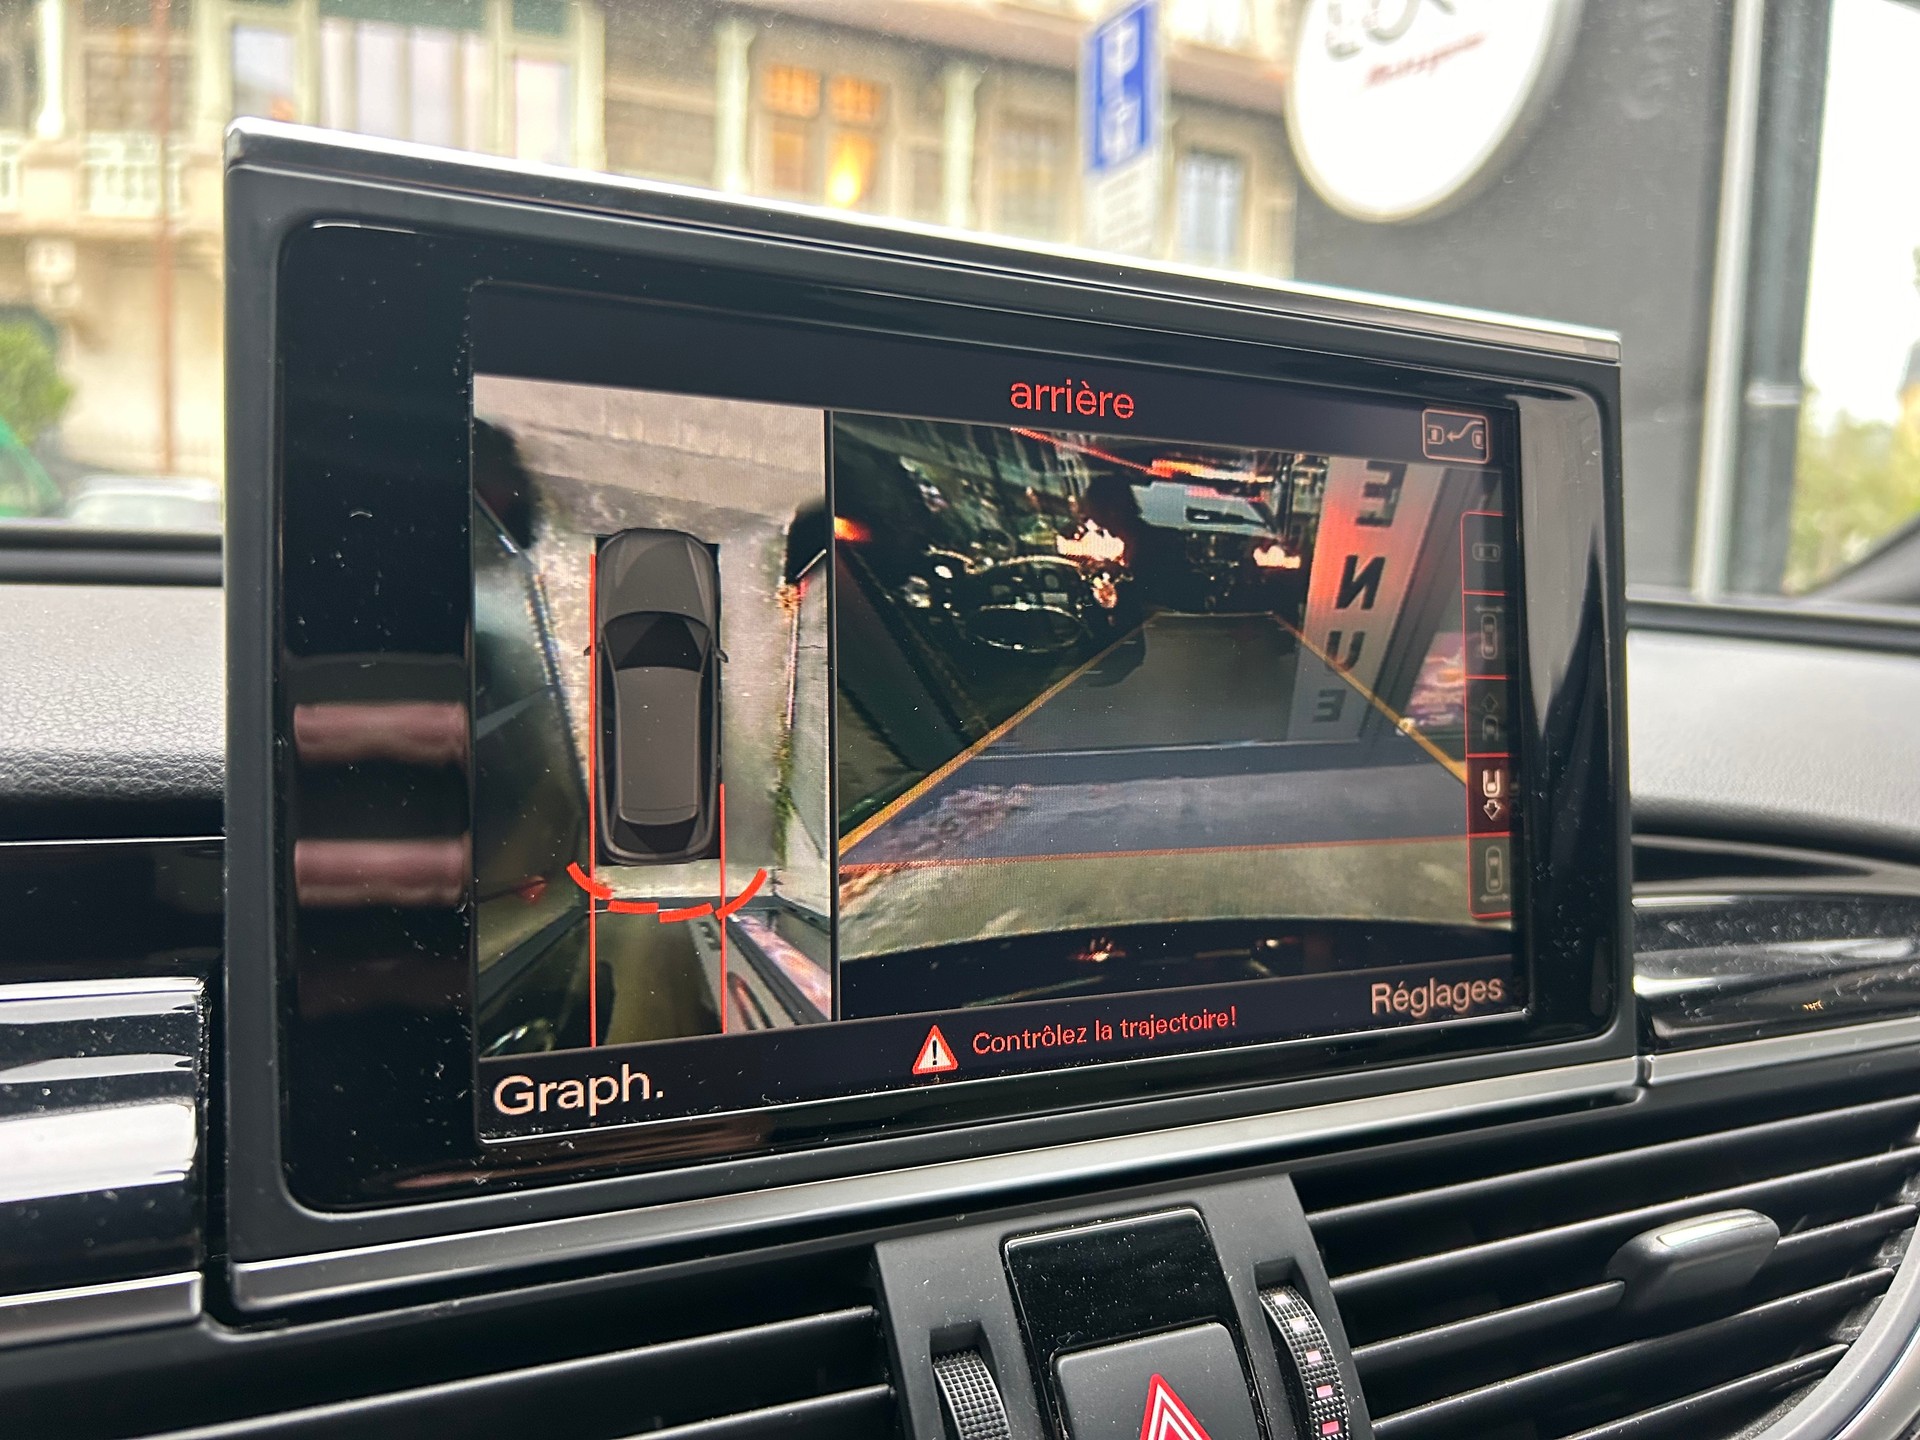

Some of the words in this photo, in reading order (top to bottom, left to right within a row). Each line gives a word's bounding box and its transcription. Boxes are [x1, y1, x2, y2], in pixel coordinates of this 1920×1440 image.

[1010, 378, 1135, 419] arrière
[1371, 977, 1504, 1018] Réglages
[972, 1023, 1087, 1055] Contrôlez
[1095, 1019, 1113, 1042] la
[1119, 1005, 1237, 1040] trajectoire!
[493, 1063, 664, 1116] Graph.
